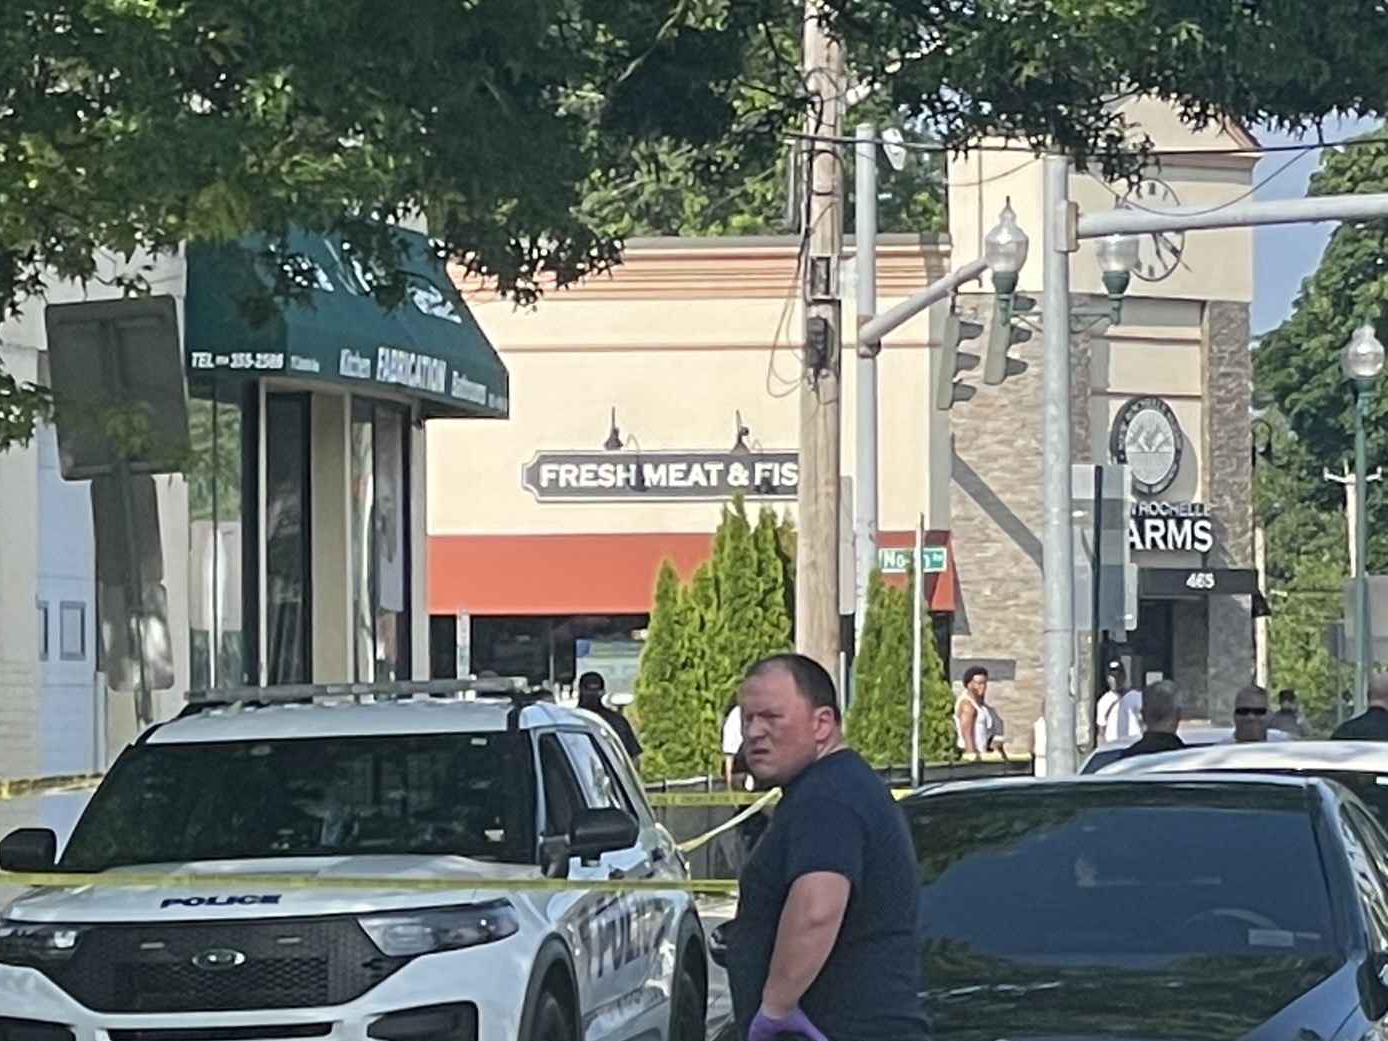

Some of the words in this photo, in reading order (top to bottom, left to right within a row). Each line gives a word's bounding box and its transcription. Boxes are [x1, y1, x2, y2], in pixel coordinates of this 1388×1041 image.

[539, 463, 636, 488] FRESH
[642, 463, 724, 488] MEAT
[727, 461, 750, 487] &
[754, 463, 799, 487] FIS
[1138, 501, 1212, 517] ROCHELLE
[1129, 518, 1213, 553] ARMS
[160, 894, 282, 909] POLICE
